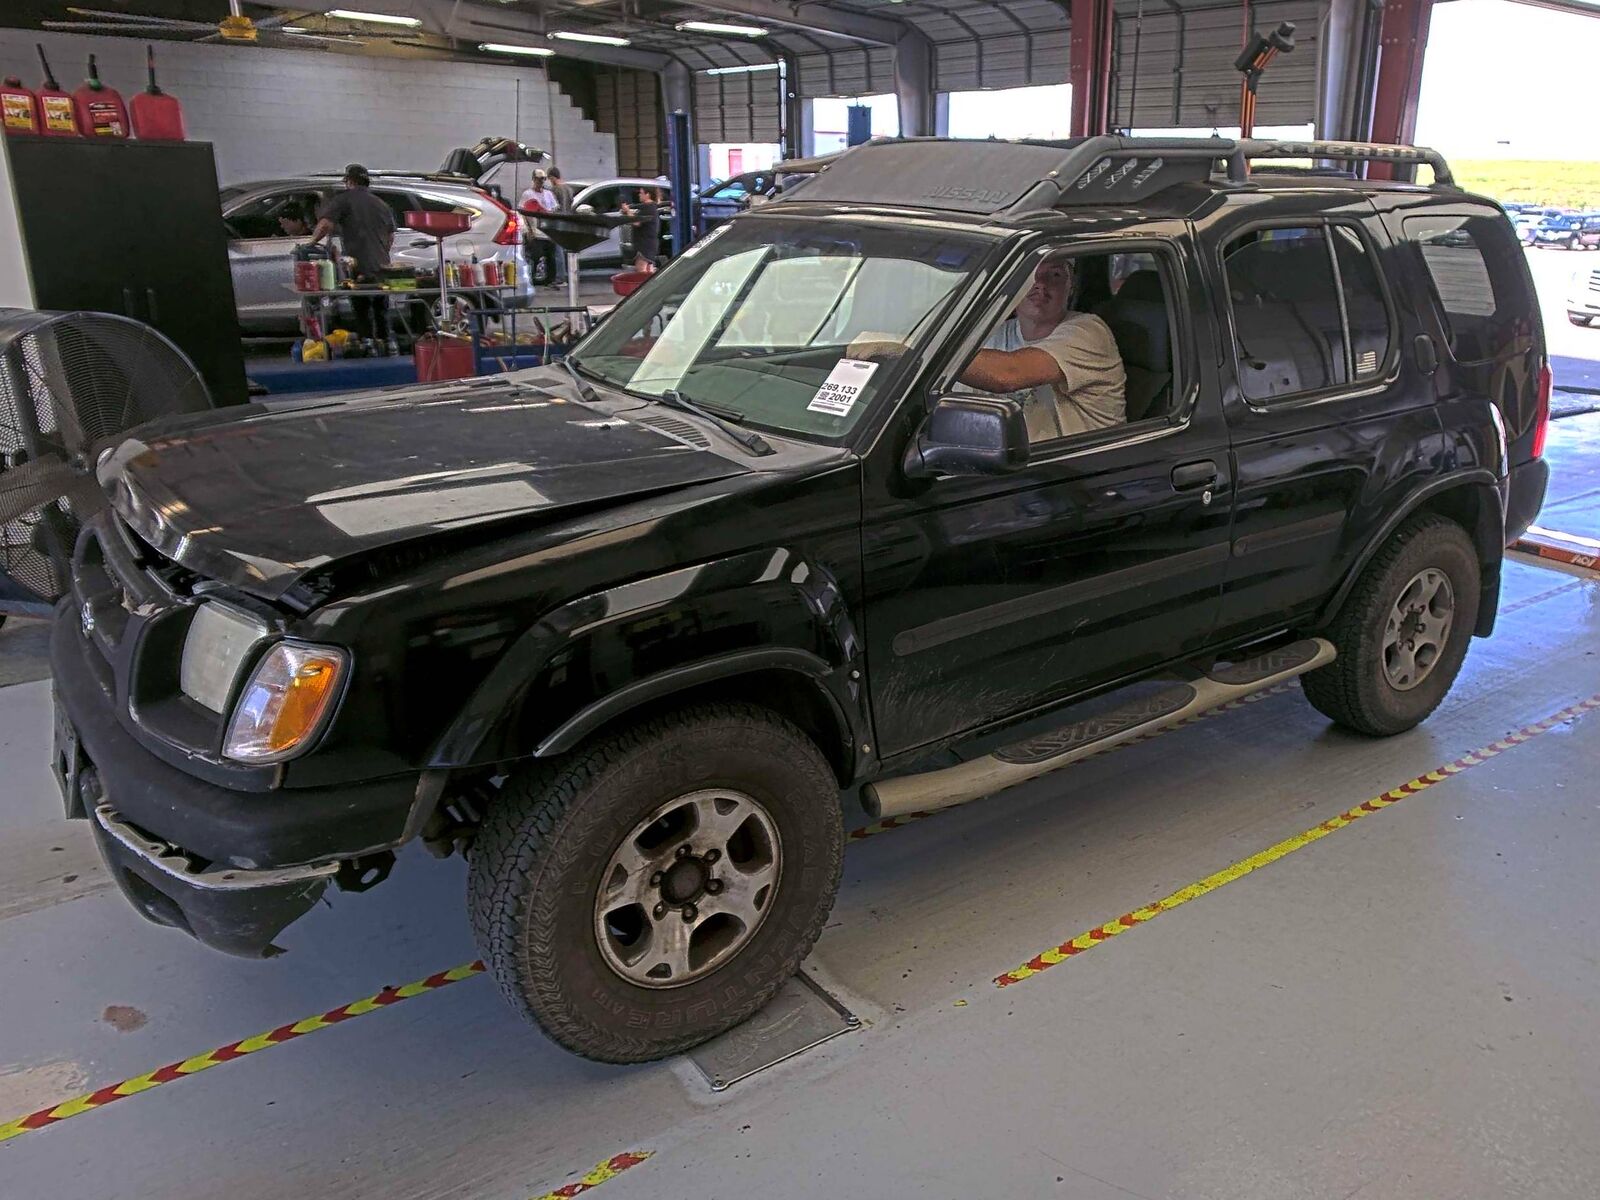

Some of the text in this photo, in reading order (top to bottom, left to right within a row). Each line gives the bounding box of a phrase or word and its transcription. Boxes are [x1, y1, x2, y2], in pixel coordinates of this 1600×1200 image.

[921, 184, 1010, 204] NISSAN
[821, 382, 857, 394] 269,133
[828, 393, 852, 403] 2001
[624, 903, 809, 1029] VENTURE
